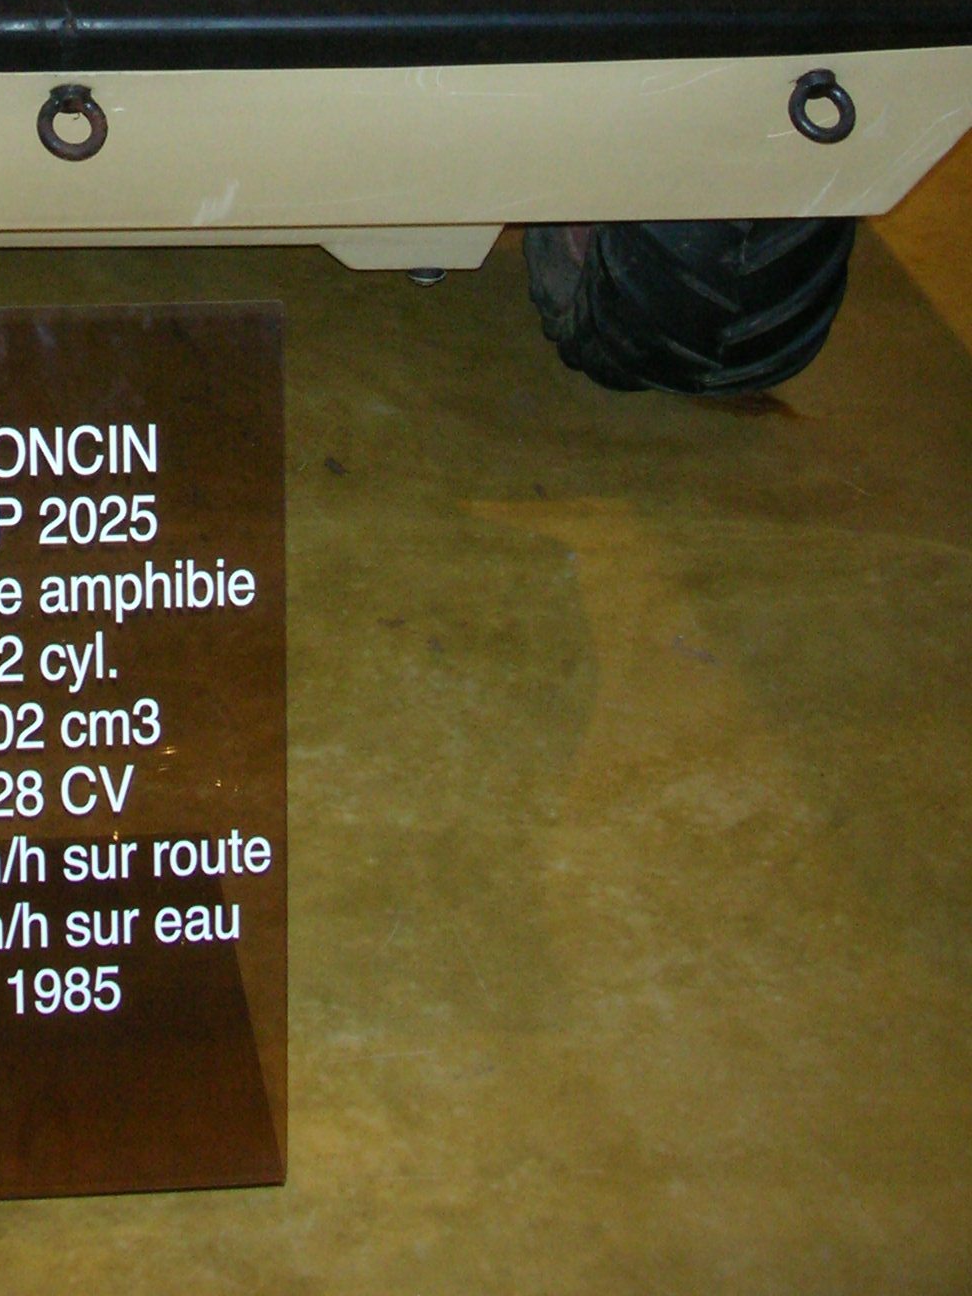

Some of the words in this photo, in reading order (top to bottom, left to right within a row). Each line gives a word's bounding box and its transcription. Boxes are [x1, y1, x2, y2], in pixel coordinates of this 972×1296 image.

[38, 494, 158, 545] 2025
[39, 558, 256, 624] amphibie
[39, 630, 118, 694] cyl.
[60, 698, 161, 748] cm3
[60, 764, 135, 815] CV
[63, 840, 138, 882] sur
[153, 829, 272, 877] route
[65, 908, 140, 948] sur
[154, 903, 240, 943] eau
[7, 965, 122, 1015] 1985
